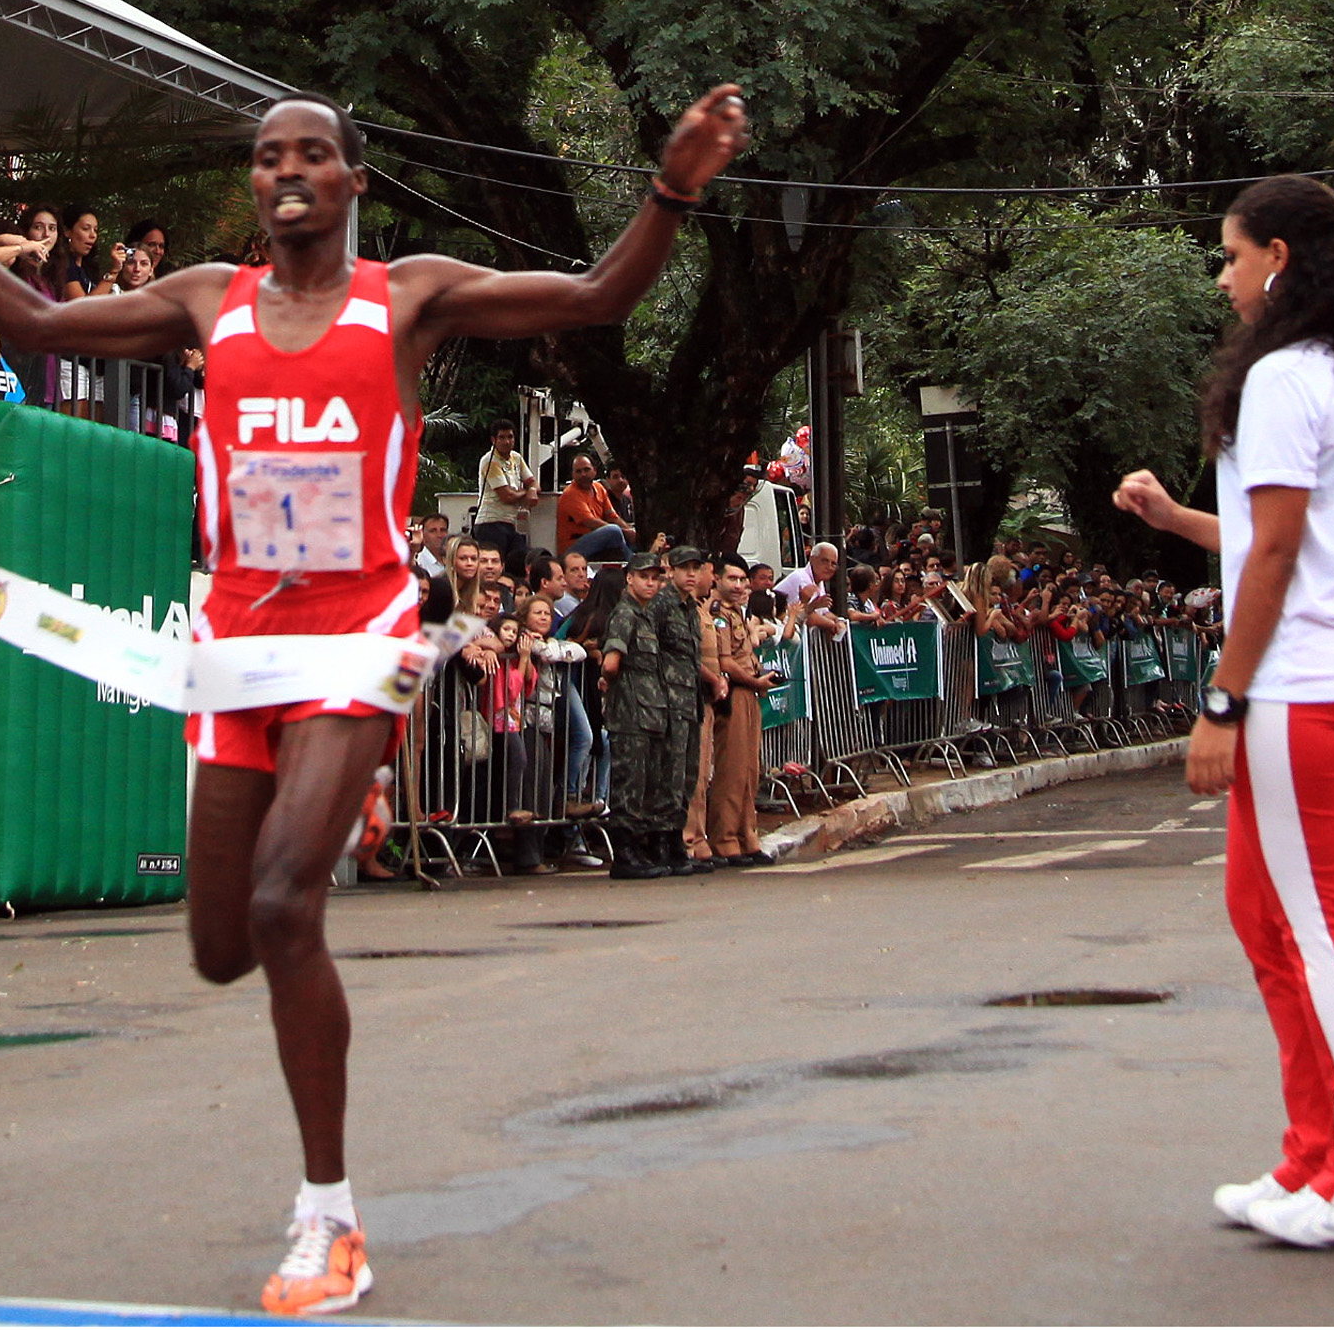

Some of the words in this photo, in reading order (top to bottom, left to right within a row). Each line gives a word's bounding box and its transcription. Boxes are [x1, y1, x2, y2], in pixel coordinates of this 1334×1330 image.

[238, 396, 360, 445] FILA
[280, 492, 295, 531] 1
[870, 637, 906, 667] Unimed
